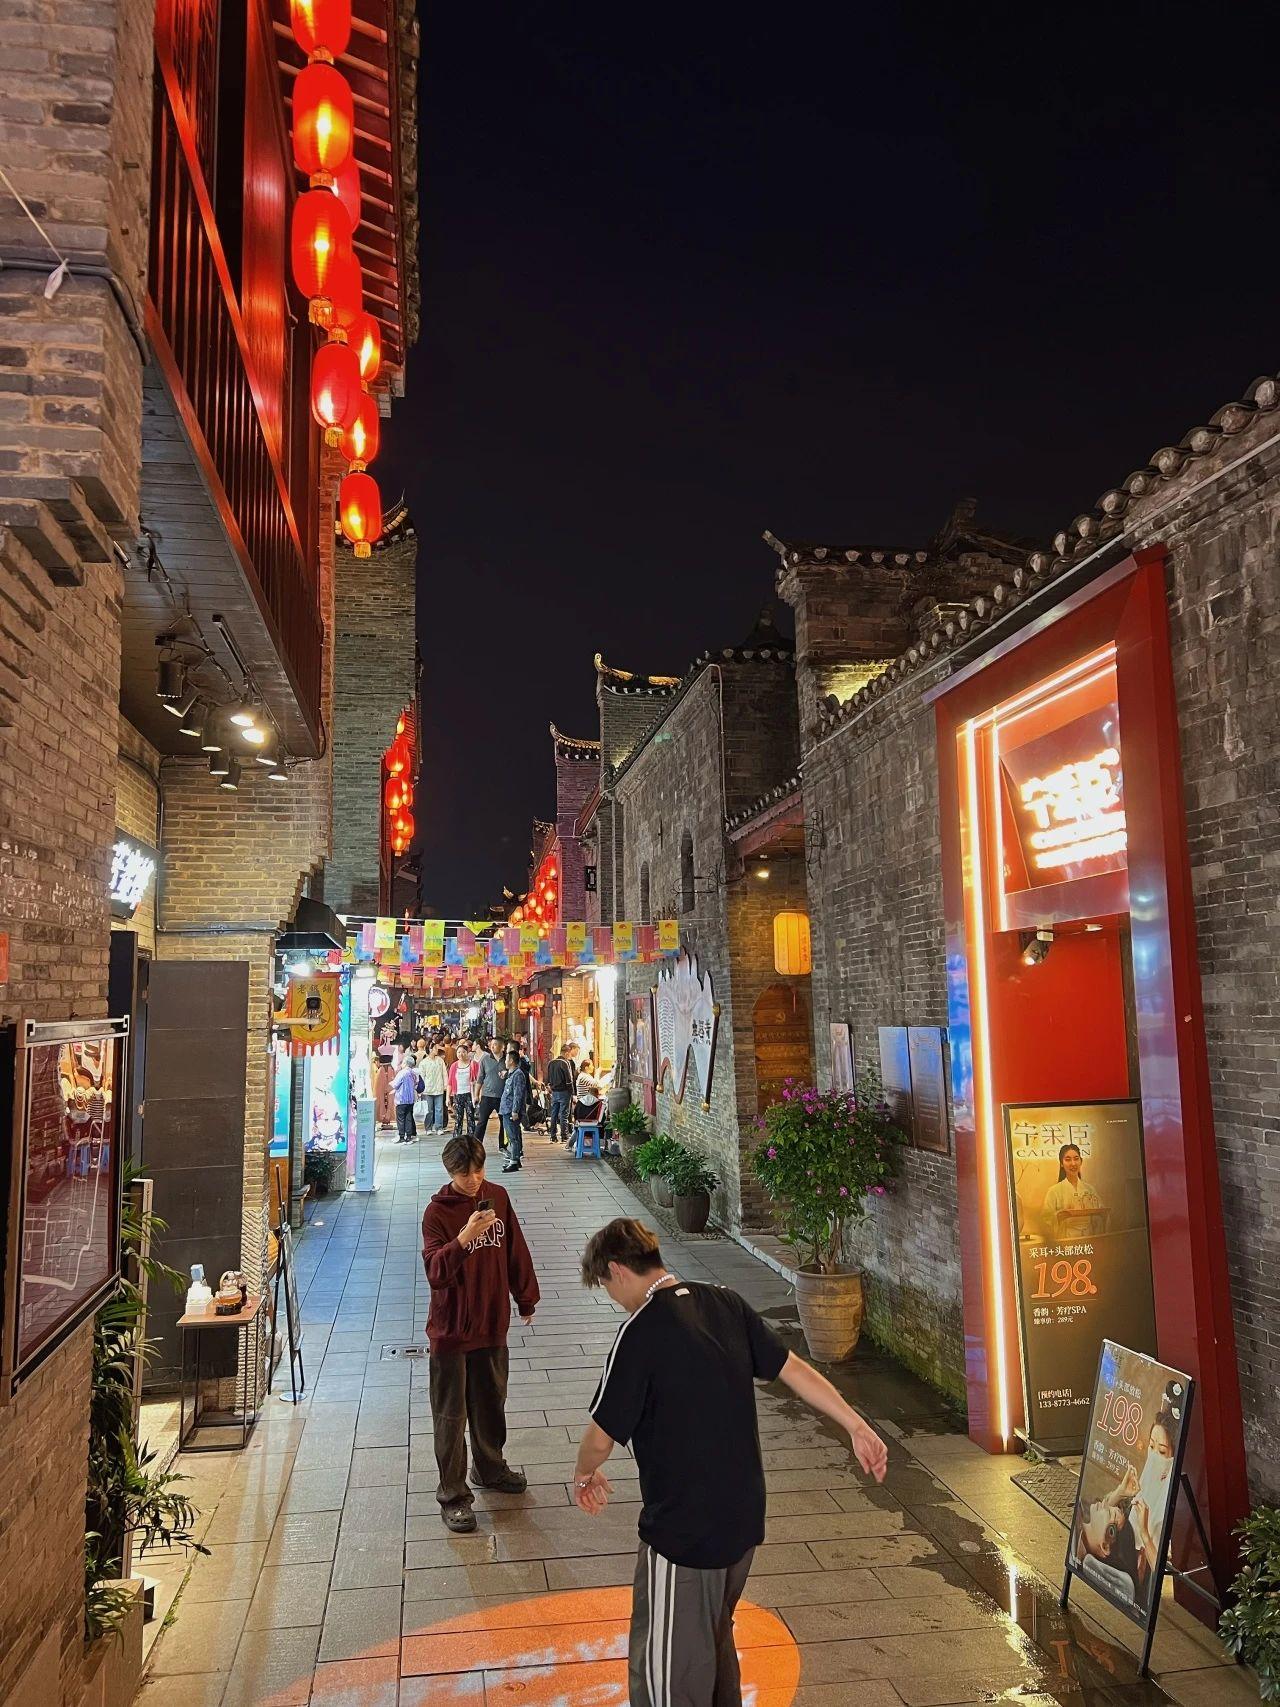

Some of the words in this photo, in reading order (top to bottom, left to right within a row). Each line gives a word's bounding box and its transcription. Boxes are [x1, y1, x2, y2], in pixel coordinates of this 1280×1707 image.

[1016, 1149, 1091, 1158] CAICN
[1029, 1243, 1094, 1259] 采耳+头部放松
[1031, 1259, 1092, 1298] 198
[1039, 1397, 1091, 1409] 133-8773-4662
[1097, 1390, 1143, 1446] 198
